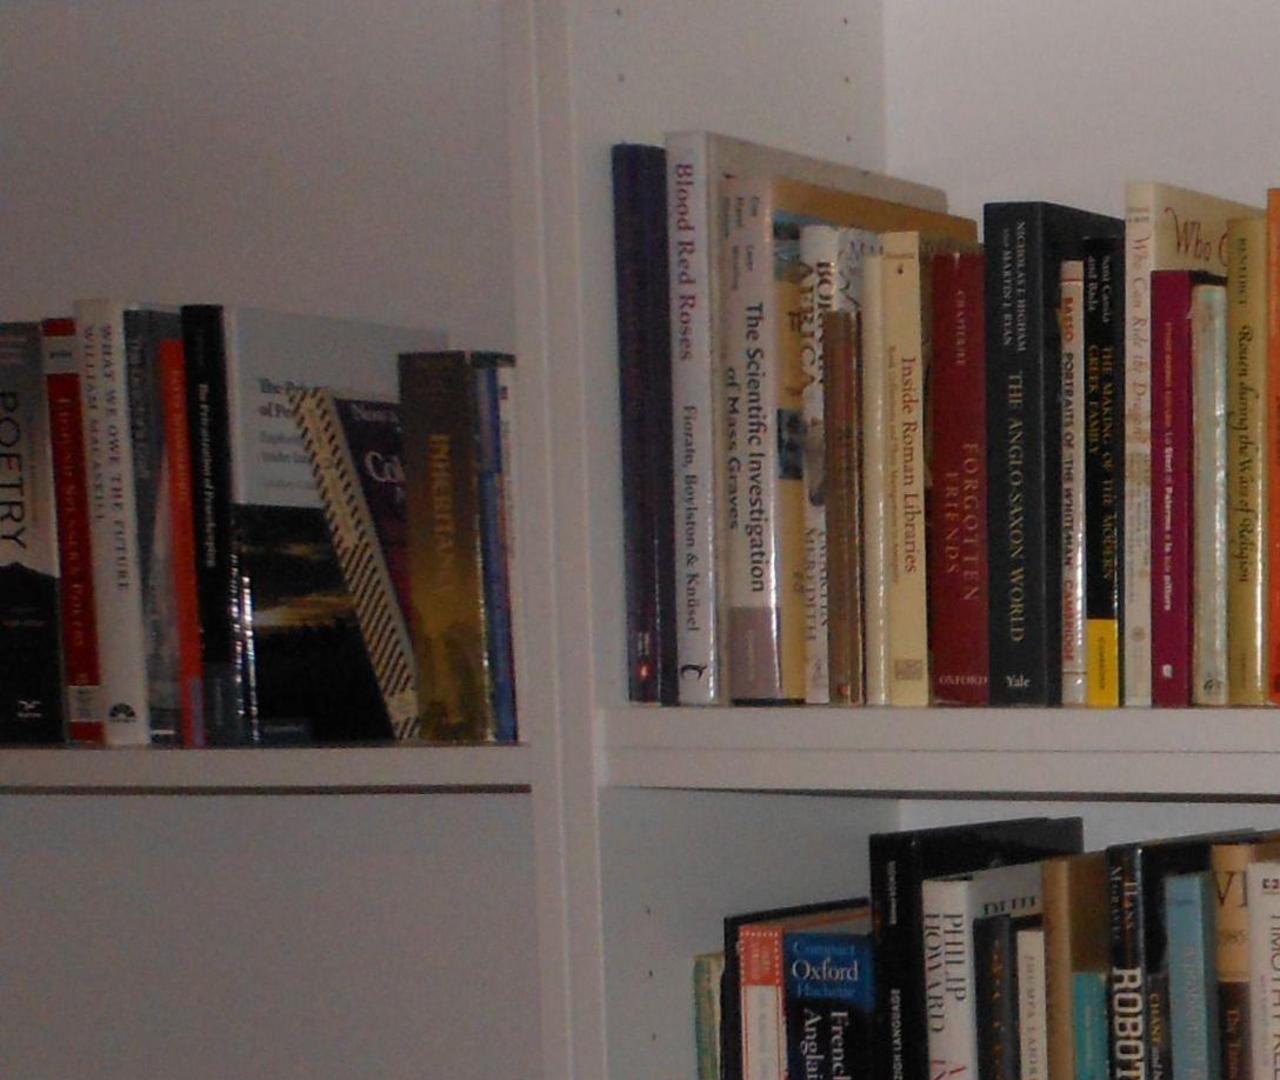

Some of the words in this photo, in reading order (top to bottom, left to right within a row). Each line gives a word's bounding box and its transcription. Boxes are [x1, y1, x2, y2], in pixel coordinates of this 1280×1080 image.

[675, 162, 695, 231] Blood
[676, 240, 696, 290] Red
[677, 295, 697, 362] Roses
[745, 302, 764, 341] The
[101, 325, 116, 379] WHAT
[1087, 345, 1098, 391] GREEK
[1101, 345, 1112, 377] THE
[1237, 325, 1253, 377] Rouen
[105, 390, 119, 415] WE
[727, 366, 740, 390] of
[745, 347, 765, 445] Scientific
[900, 355, 918, 415] Inside
[1007, 370, 1023, 408] THE
[727, 396, 740, 449] Mass
[1087, 402, 1098, 455] FAMILY
[1101, 382, 1112, 444] MAKING
[1229, 381, 1258, 430] during
[107, 425, 122, 463] OWE
[901, 421, 918, 485] Roman
[1102, 453, 1112, 471] OF
[1238, 435, 1254, 454] the
[110, 474, 125, 512] THE
[727, 456, 740, 530] Graves
[1008, 418, 1024, 559] ANGLO-SAXON
[1102, 478, 1112, 507] THE
[1238, 458, 1253, 496] Wars
[747, 453, 767, 593] Investigation
[902, 492, 919, 574] Libraries
[944, 471, 959, 574] FRIENDS
[961, 442, 979, 603] FORGOTTEN
[1236, 499, 1254, 514] of
[112, 519, 130, 592] FUTURE
[1102, 514, 1112, 579] MODERN
[1234, 518, 1253, 582] Religion
[1009, 569, 1024, 642] WORLD
[790, 960, 858, 982] Oxford
[924, 912, 946, 1032] HOWARD
[944, 912, 967, 1001] PHILIP
